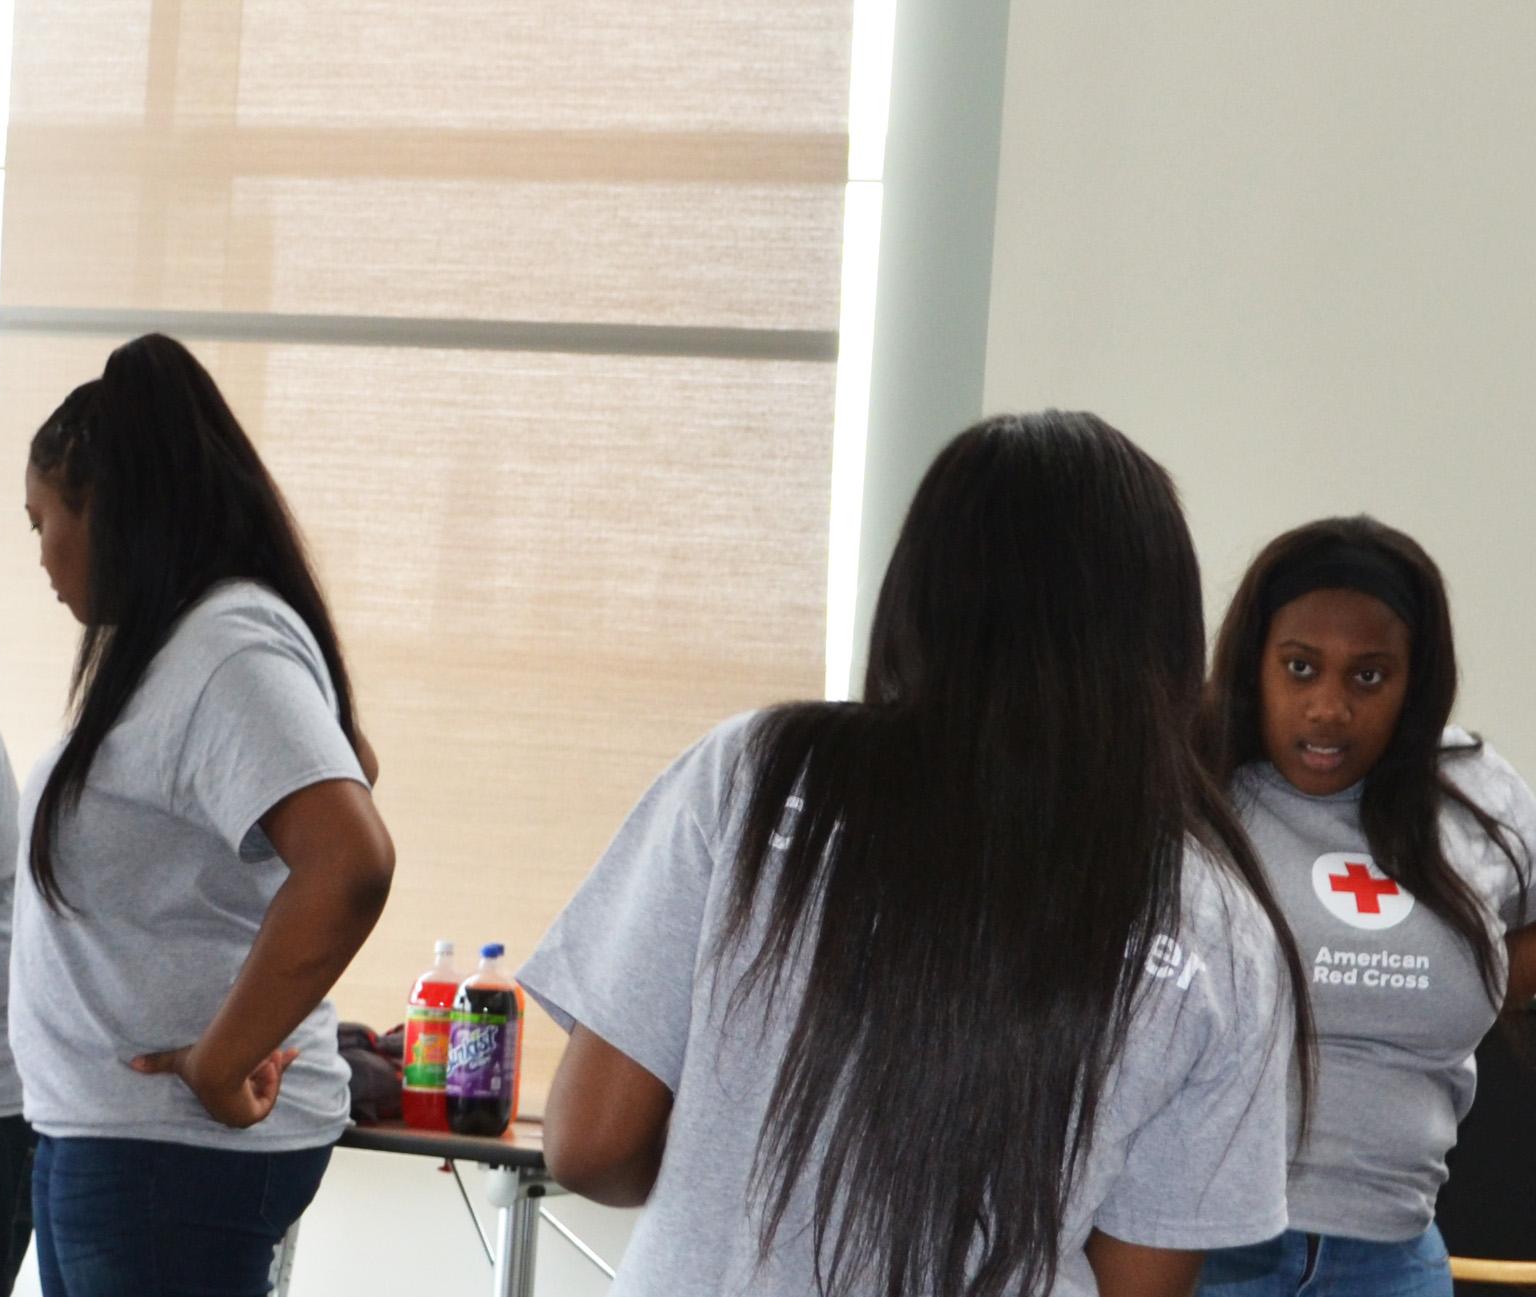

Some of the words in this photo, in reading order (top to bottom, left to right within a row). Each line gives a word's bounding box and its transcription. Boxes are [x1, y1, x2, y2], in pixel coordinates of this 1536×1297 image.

[1314, 946, 1430, 969] American
[1312, 966, 1358, 985] Red
[1363, 968, 1430, 989] Cross
